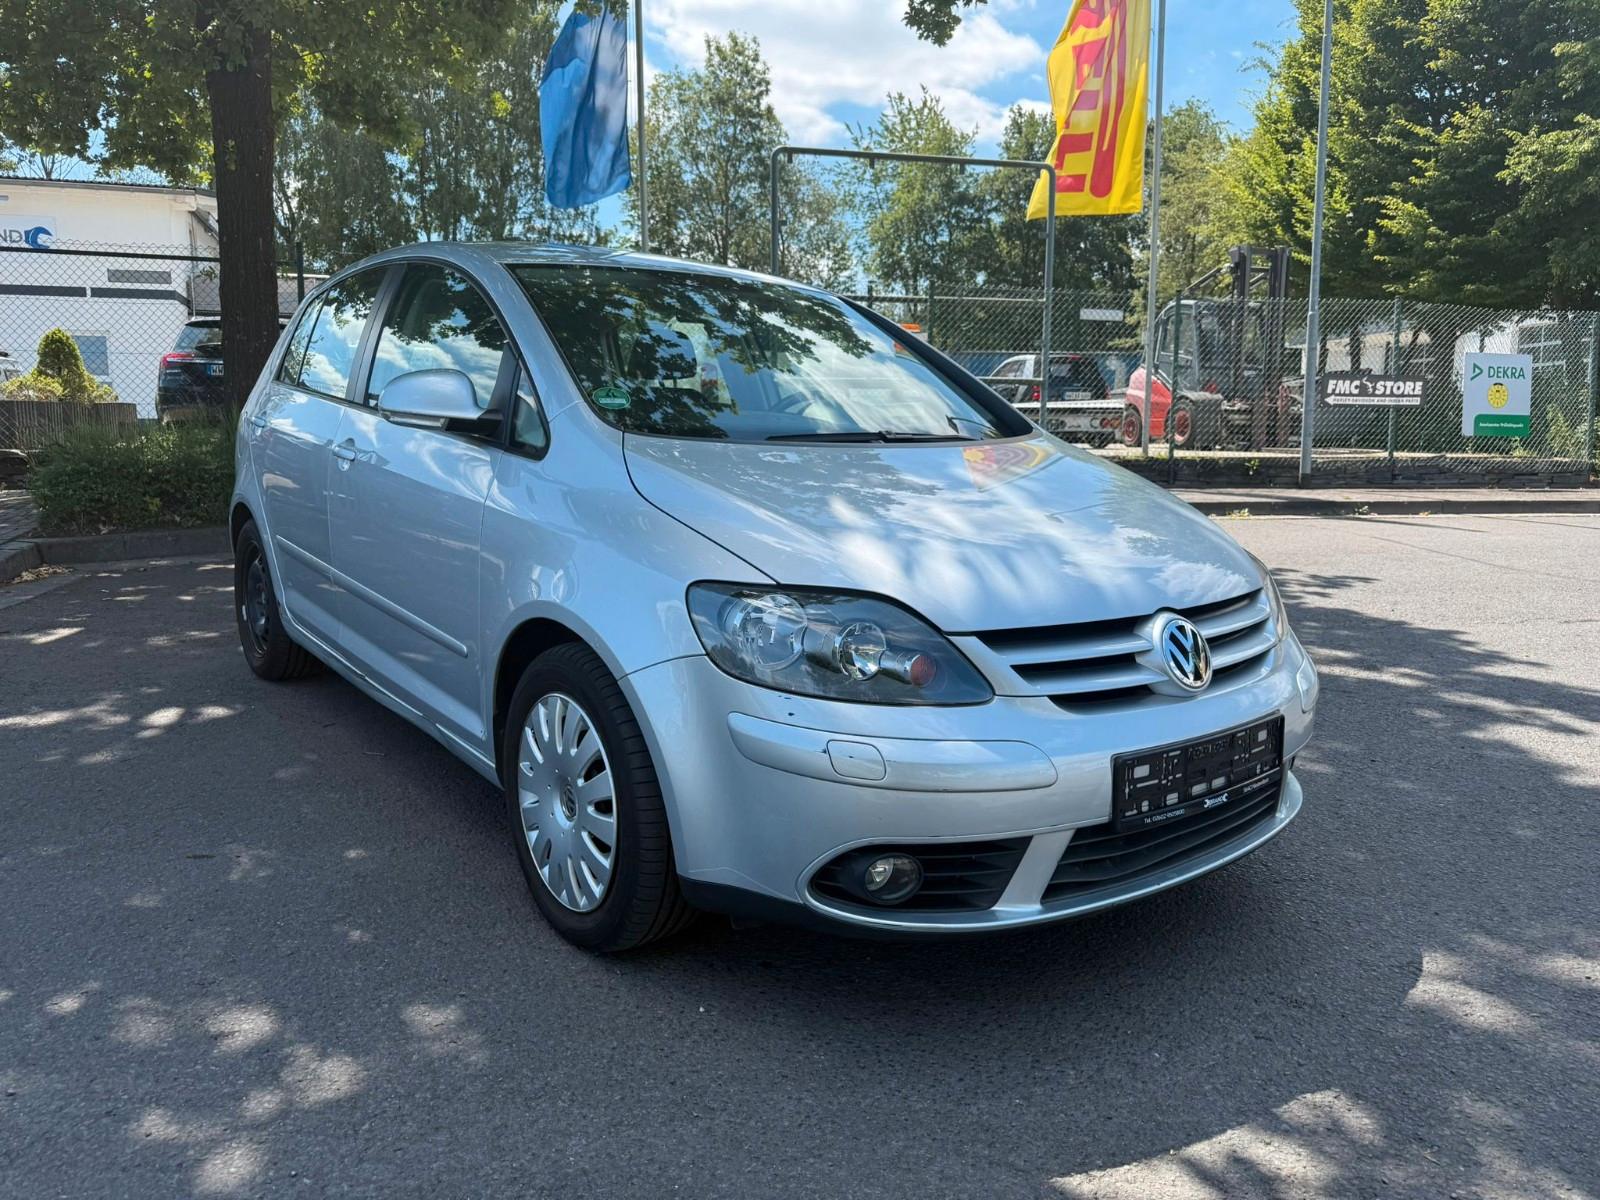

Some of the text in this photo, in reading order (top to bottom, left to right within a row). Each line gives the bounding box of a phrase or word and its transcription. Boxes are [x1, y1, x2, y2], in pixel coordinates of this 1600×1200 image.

[1488, 366, 1526, 379] DEKRA
[1327, 380, 1423, 395] FMC STORE
